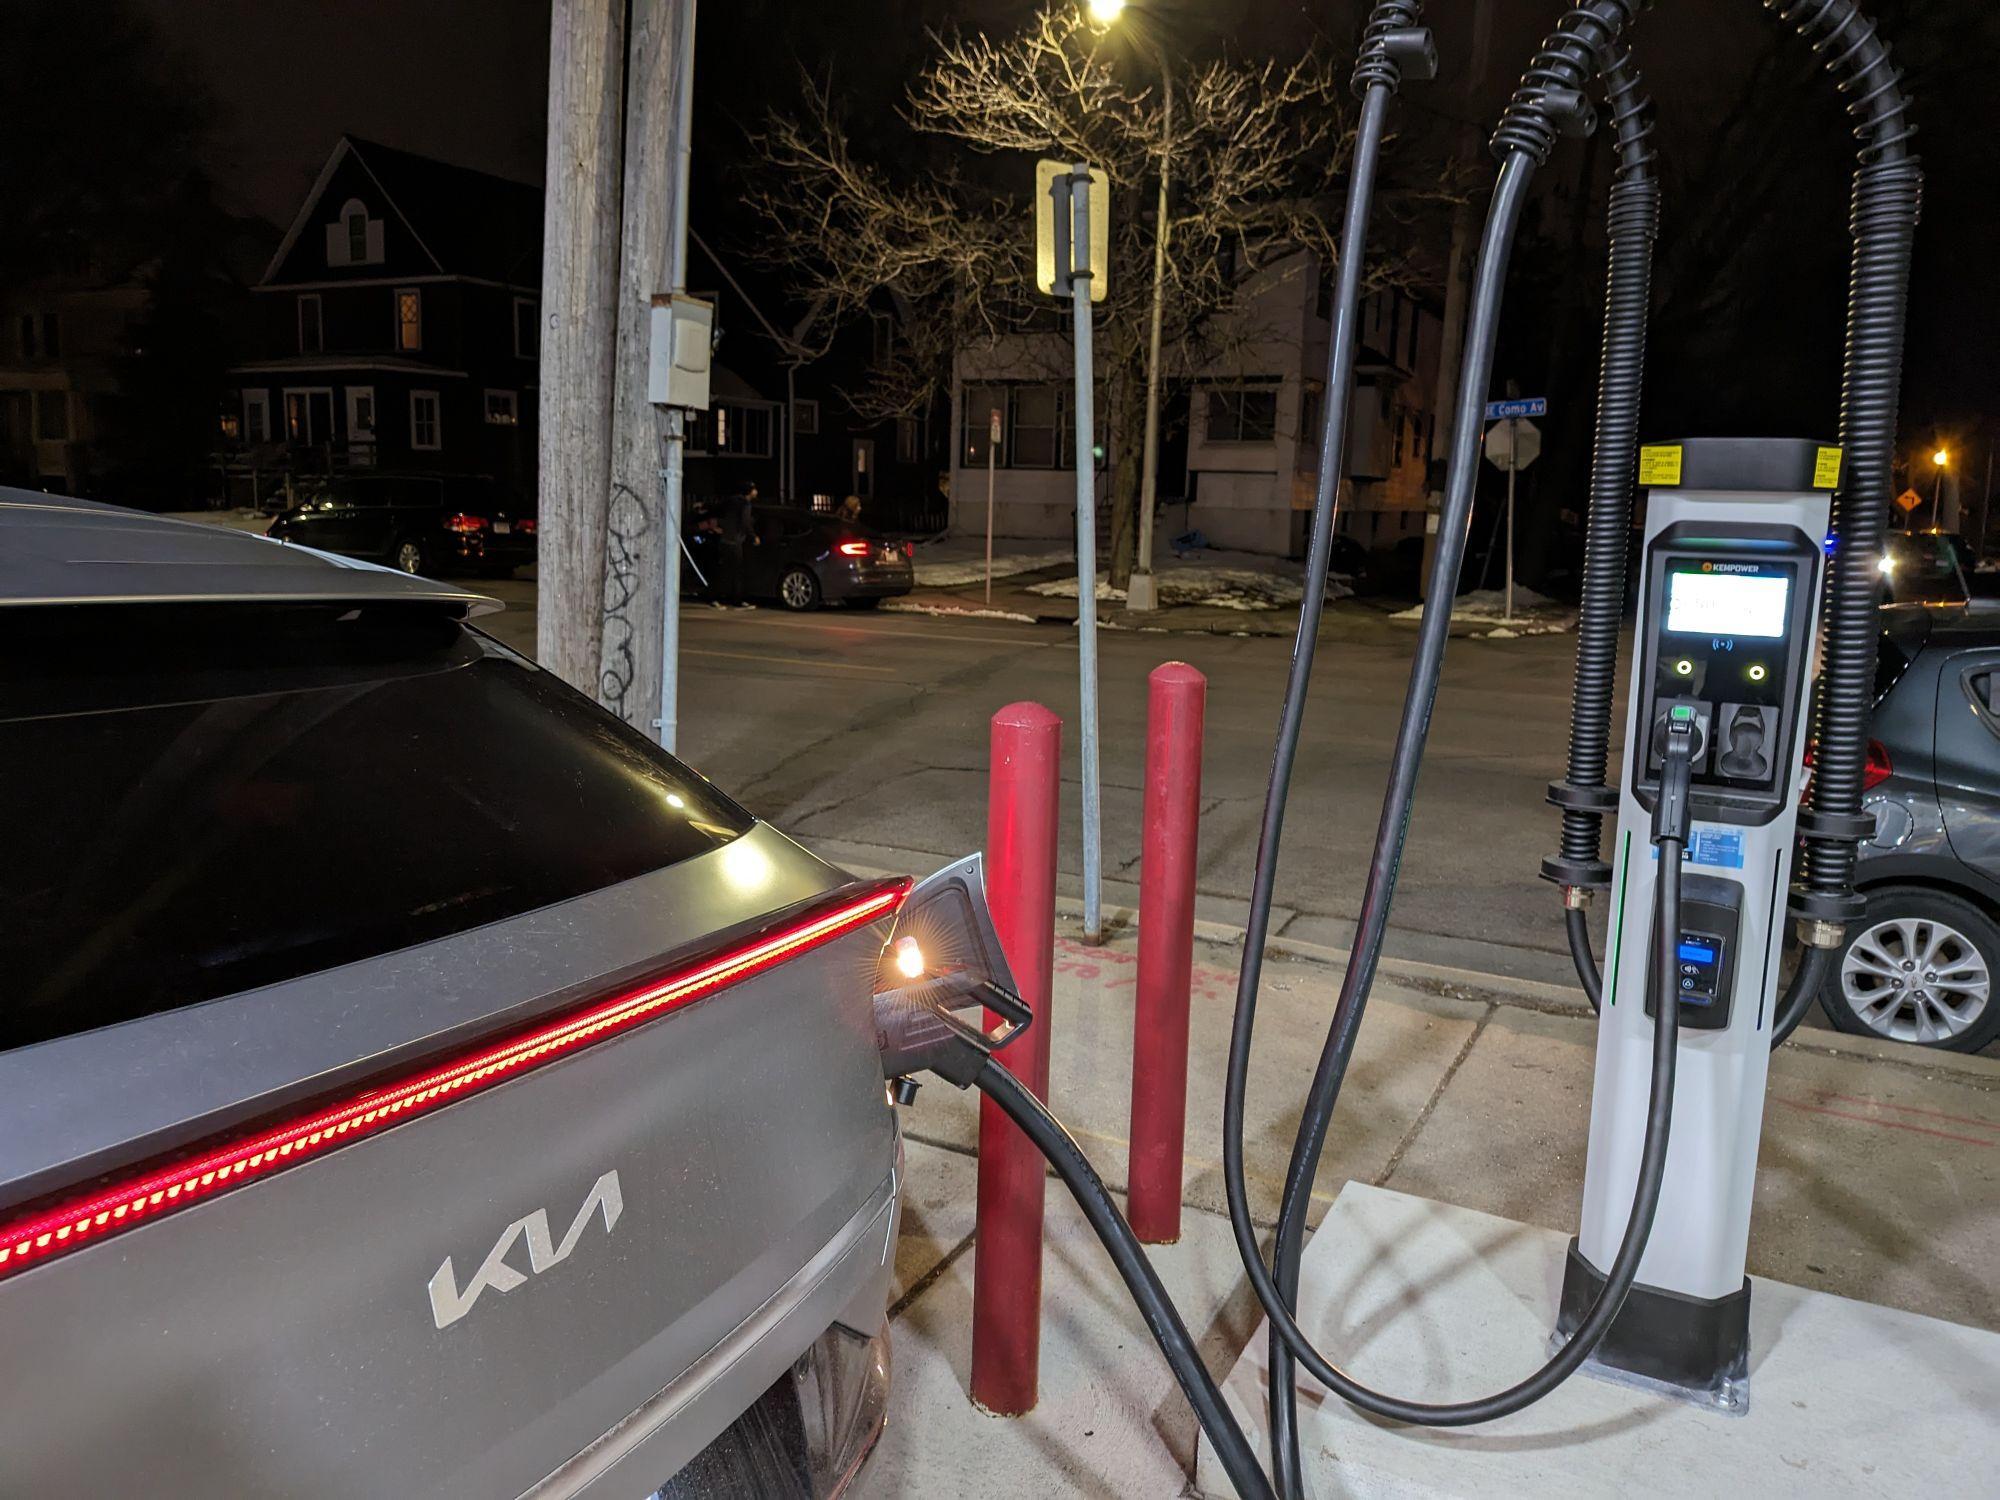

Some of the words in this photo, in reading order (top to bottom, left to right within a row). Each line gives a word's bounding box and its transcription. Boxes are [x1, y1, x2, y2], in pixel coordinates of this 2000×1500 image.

[1498, 404, 1526, 416] Como
[1530, 401, 1543, 413] Av
[1712, 563, 1759, 573] KEMPOWER
[428, 1169, 623, 1329] KIA
